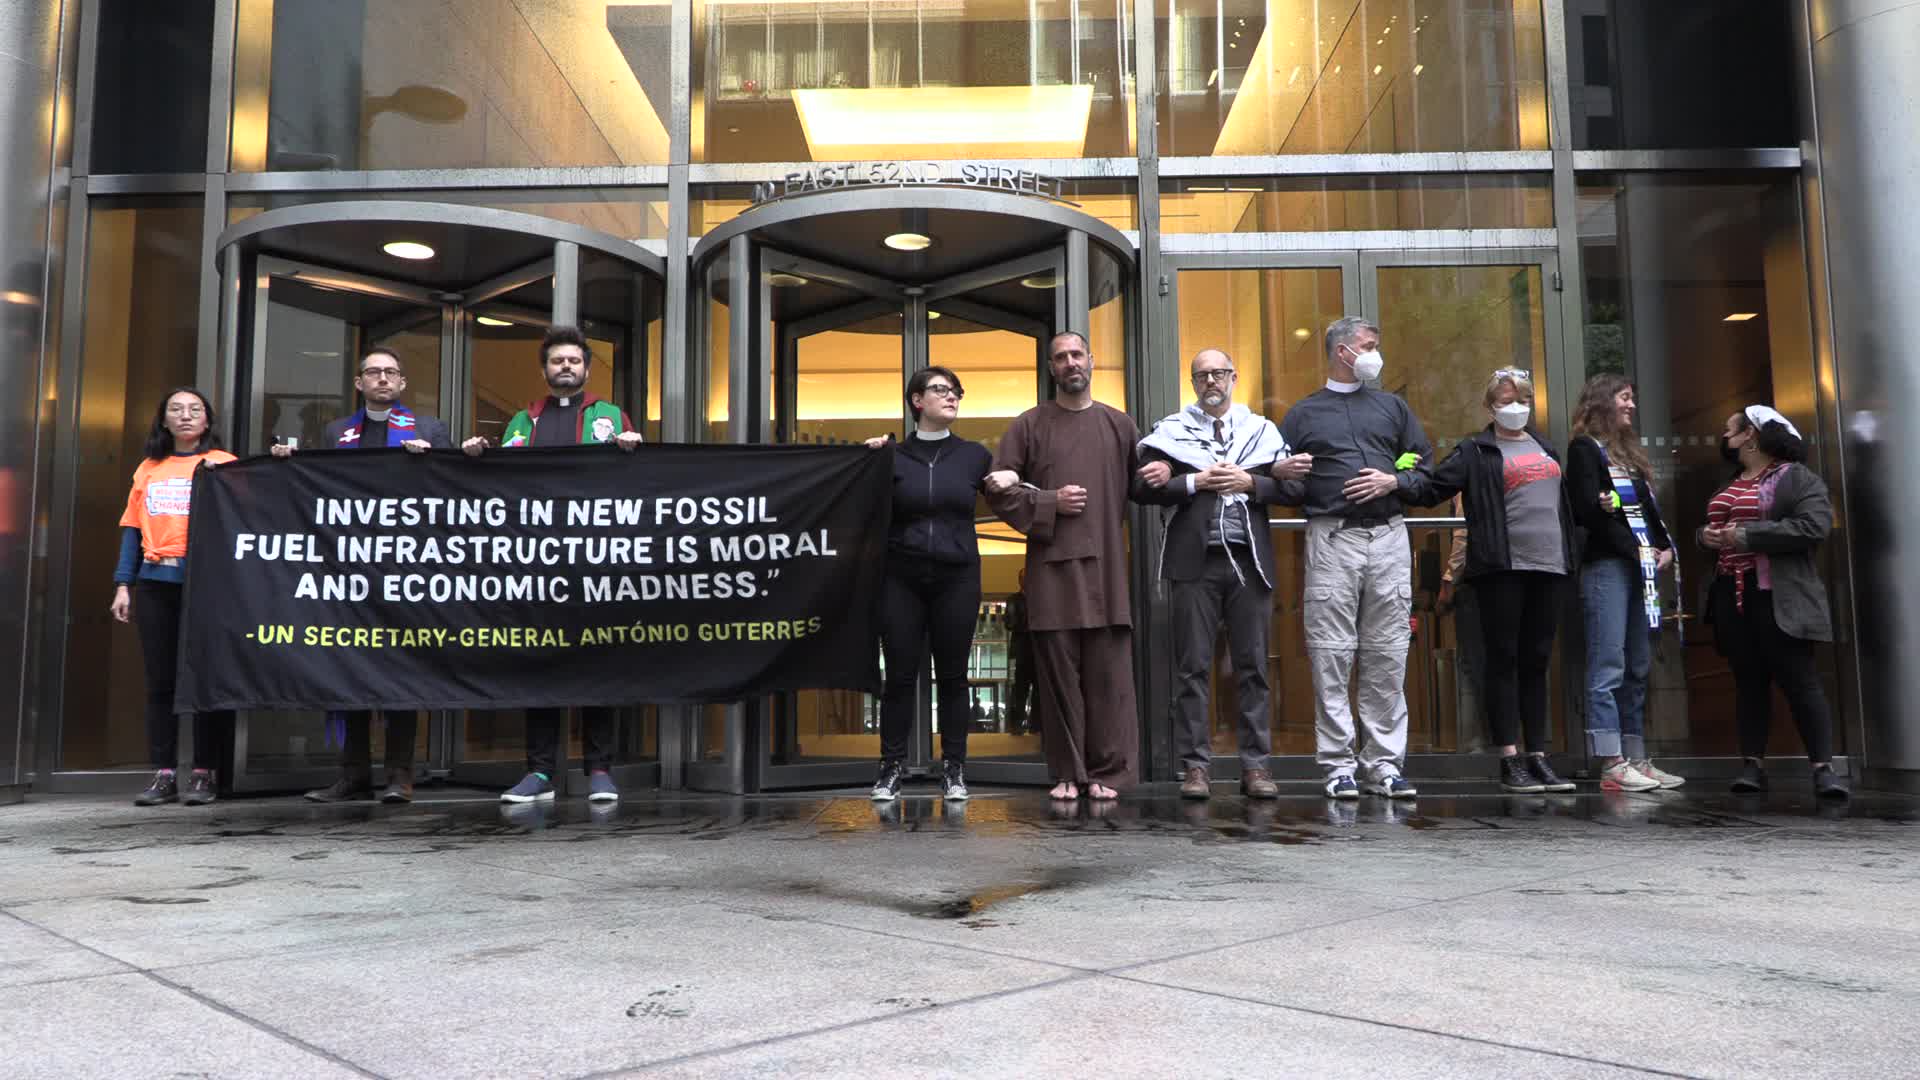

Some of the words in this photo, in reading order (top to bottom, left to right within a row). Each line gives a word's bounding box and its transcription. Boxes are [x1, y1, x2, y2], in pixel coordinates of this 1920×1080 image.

[784, 162, 855, 194] EAST
[869, 162, 942, 184] 52ND
[961, 164, 1065, 200] STREET
[315, 497, 507, 527] INVESTING
[519, 499, 554, 527] IN
[566, 498, 644, 528] NEW
[655, 495, 778, 525] FOSSIL
[233, 532, 324, 563] FUEL
[337, 534, 654, 566] INFRASTRUCTURE
[665, 535, 699, 564] IS
[709, 528, 838, 562] MORAL
[293, 572, 370, 602] AND
[383, 573, 569, 603] ECONOMIC
[245, 624, 295, 647] -UN
[303, 625, 571, 648] SECRETARY-GENERAL
[580, 619, 690, 645] ANTÓNIO
[698, 617, 822, 642] GUTERRES
